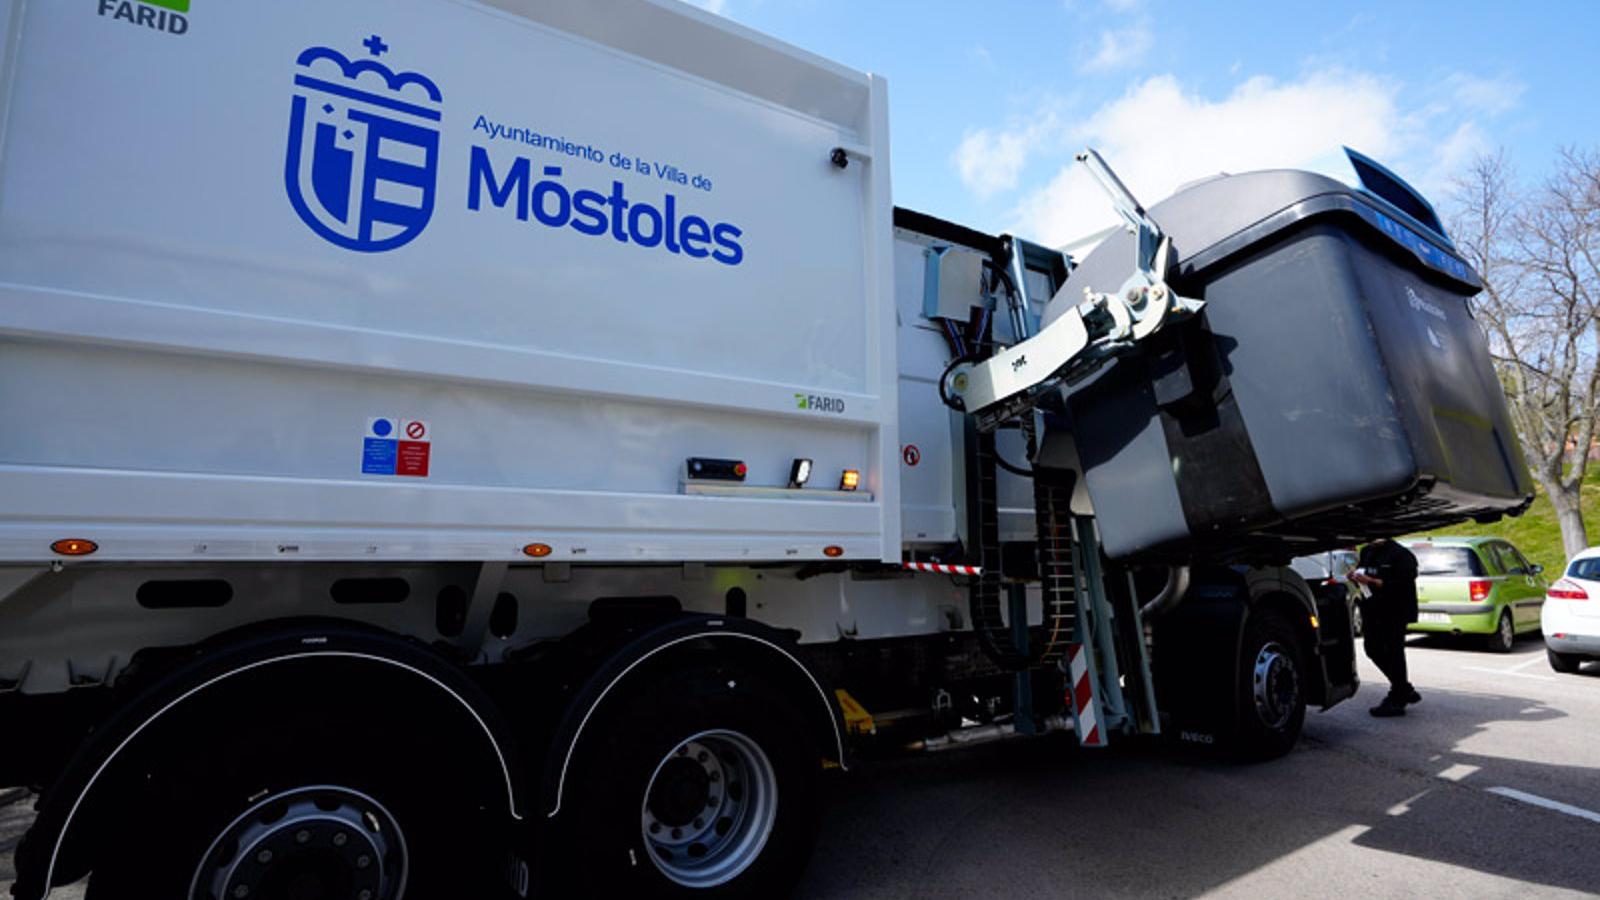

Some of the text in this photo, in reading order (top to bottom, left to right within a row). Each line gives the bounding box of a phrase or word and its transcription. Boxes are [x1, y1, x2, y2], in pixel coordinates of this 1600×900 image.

[98, 0, 189, 35] FARID
[473, 115, 713, 191] Ayuntamiento de la Villa de
[467, 145, 744, 265] Móstoles
[807, 395, 845, 414] FARID
